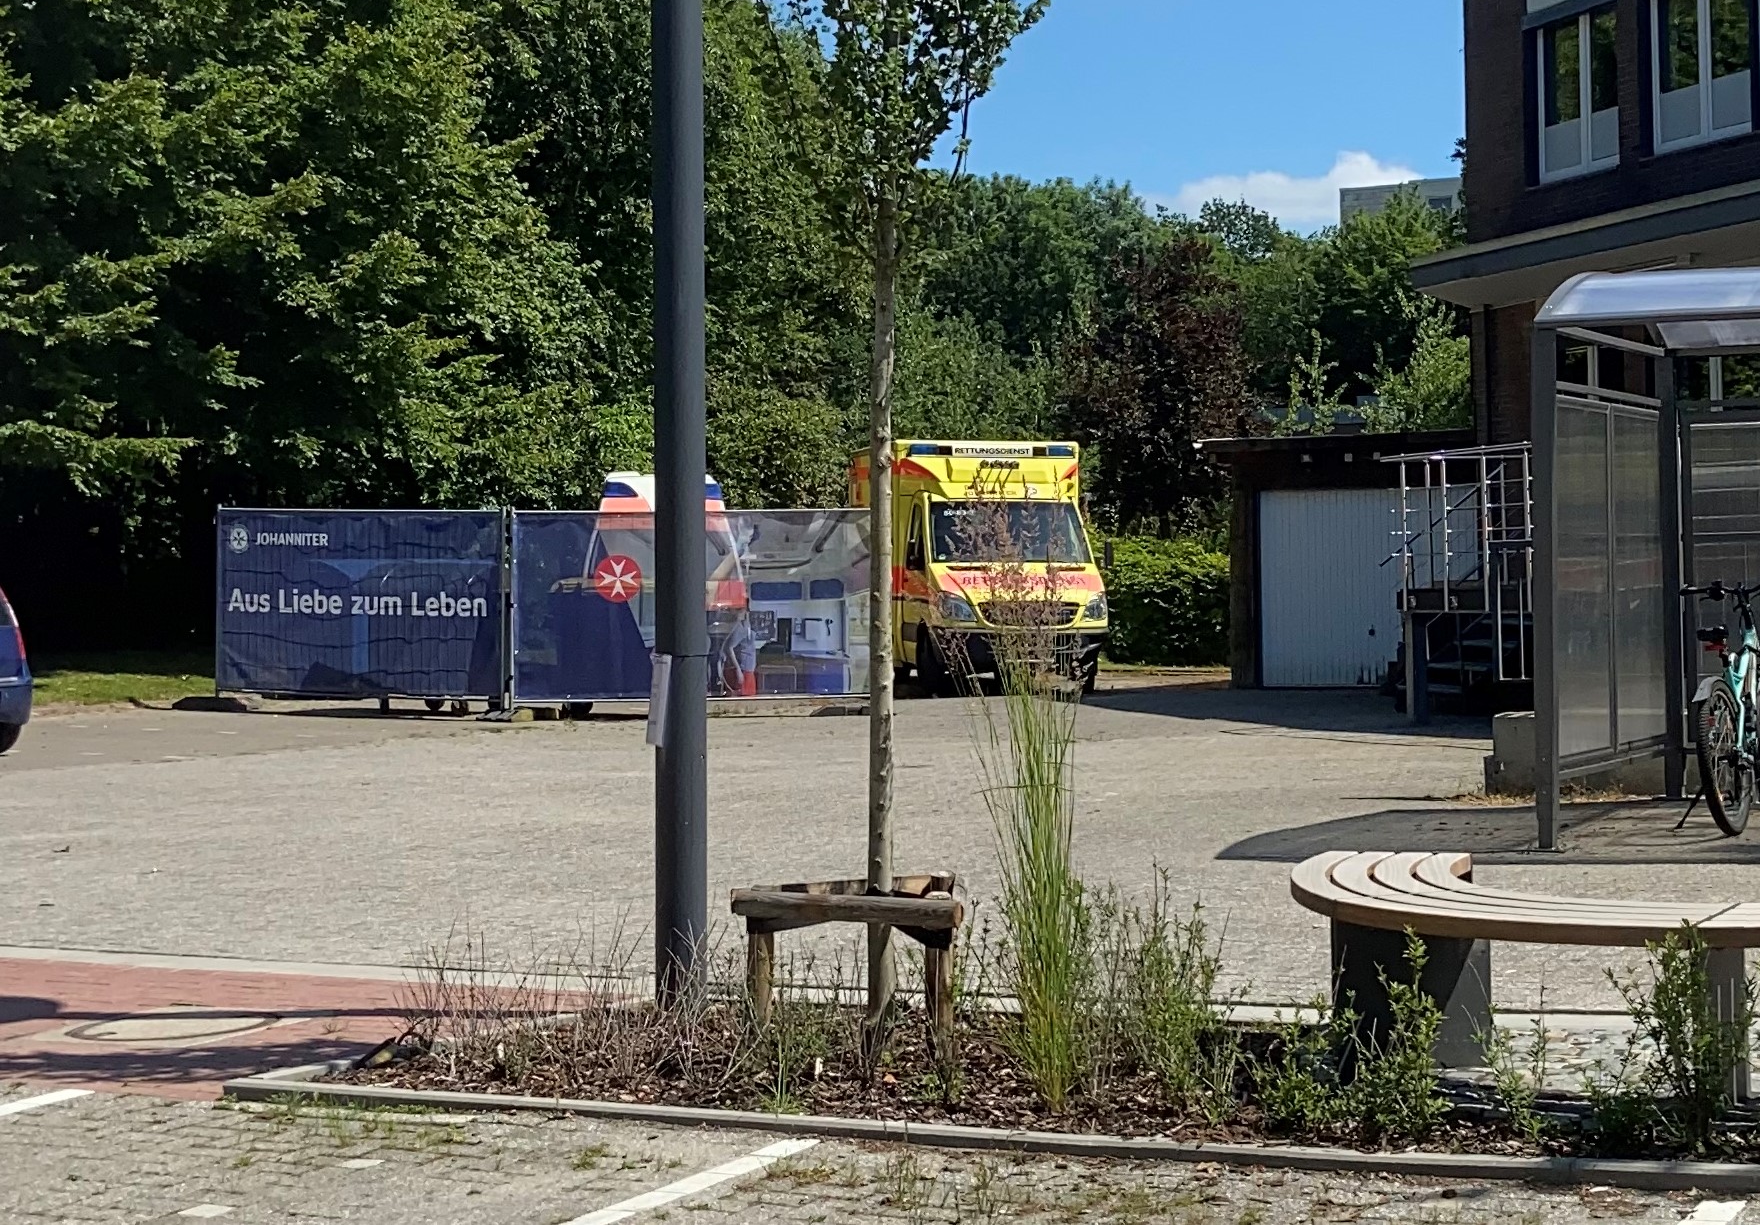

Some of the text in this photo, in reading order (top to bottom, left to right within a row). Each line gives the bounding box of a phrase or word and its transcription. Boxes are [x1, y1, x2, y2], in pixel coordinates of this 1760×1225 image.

[954, 447, 1030, 455] RETTUNGSDIENST
[254, 532, 329, 547] JOHANNITER
[227, 587, 488, 618] Aus Liebe zum Leben
